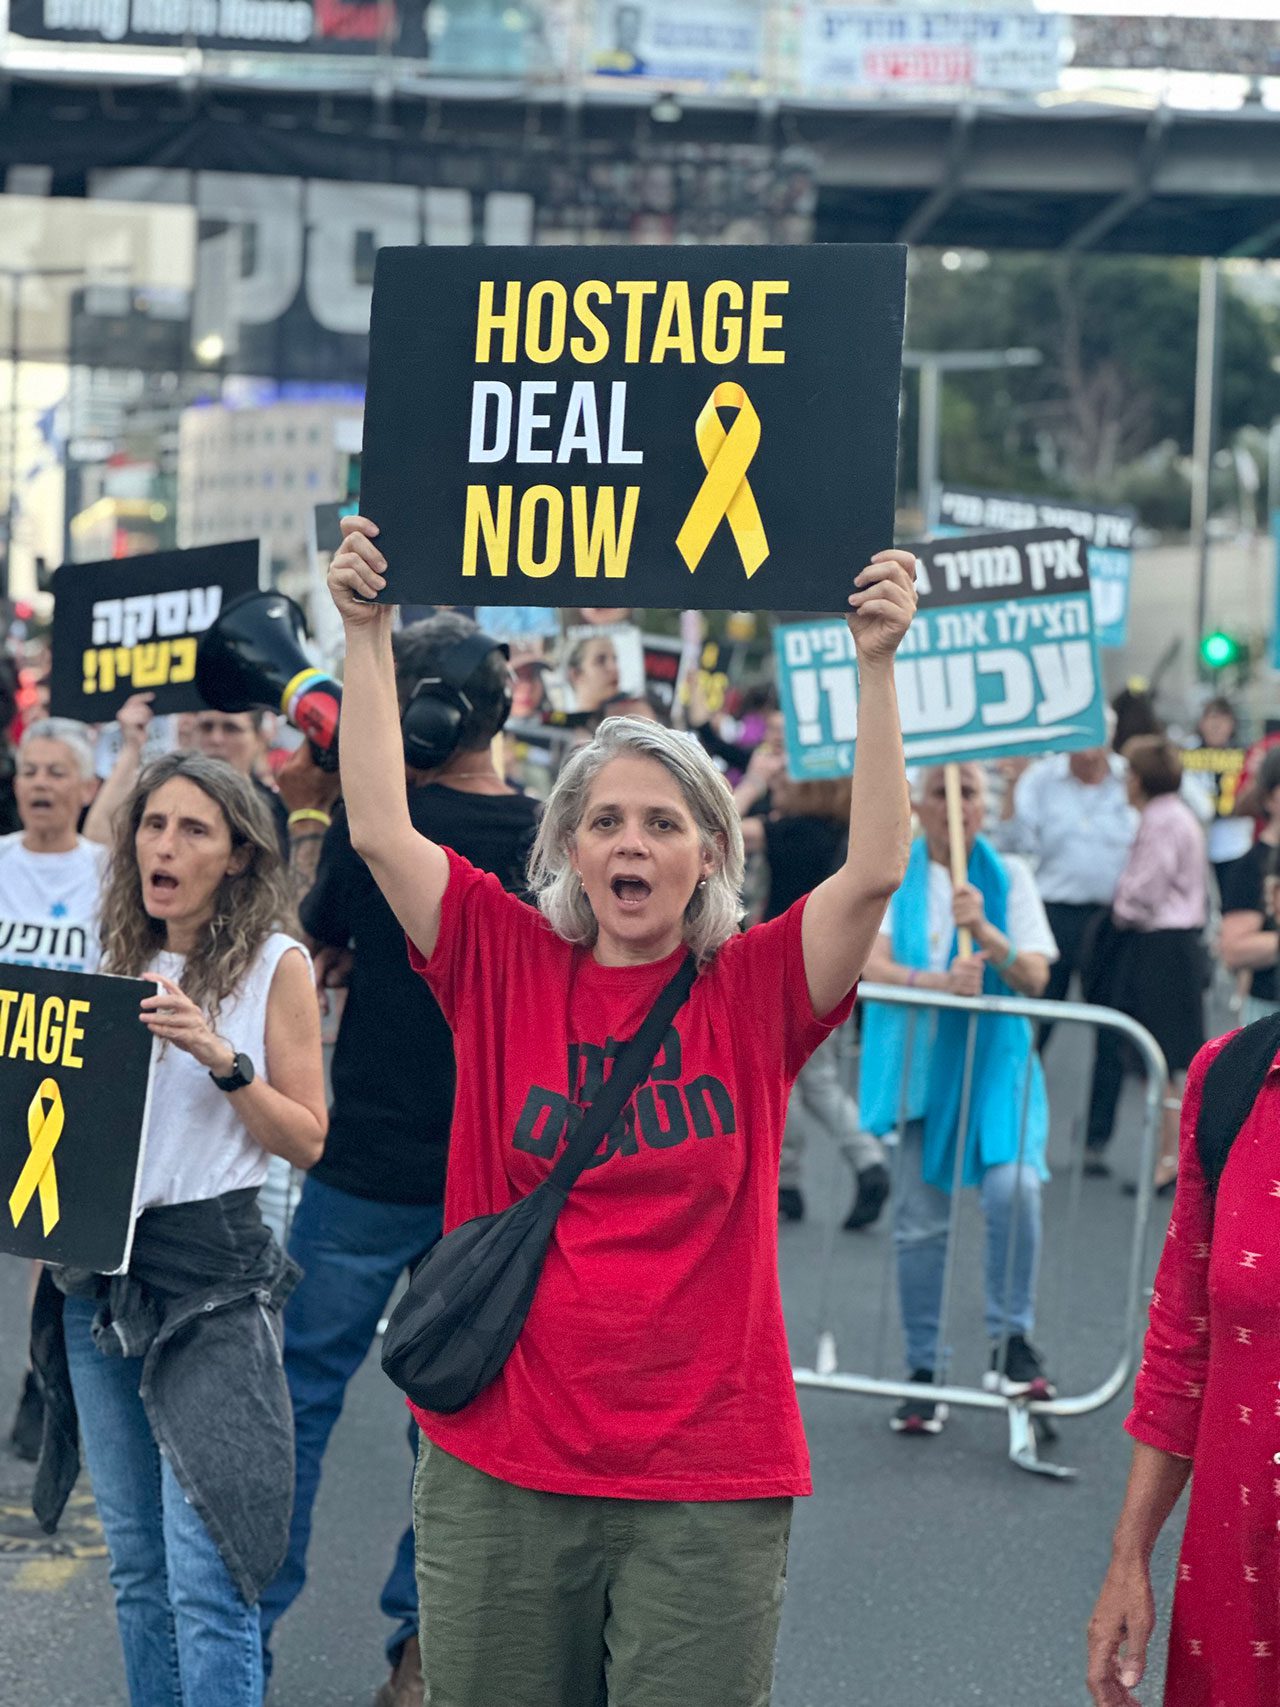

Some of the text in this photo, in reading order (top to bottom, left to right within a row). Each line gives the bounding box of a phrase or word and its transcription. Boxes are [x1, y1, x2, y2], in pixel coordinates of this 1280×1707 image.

[475, 280, 790, 365] HOSTAGE
[468, 380, 644, 464] DEAL
[462, 484, 640, 579] NOW
[932, 545, 1023, 592] מחיר
[1025, 537, 1084, 591] אין
[92, 584, 223, 649] עסקה
[936, 609, 990, 650] את
[992, 599, 1090, 643] הצילו
[82, 636, 198, 695] כשיו!
[791, 640, 1095, 746] עכשו!
